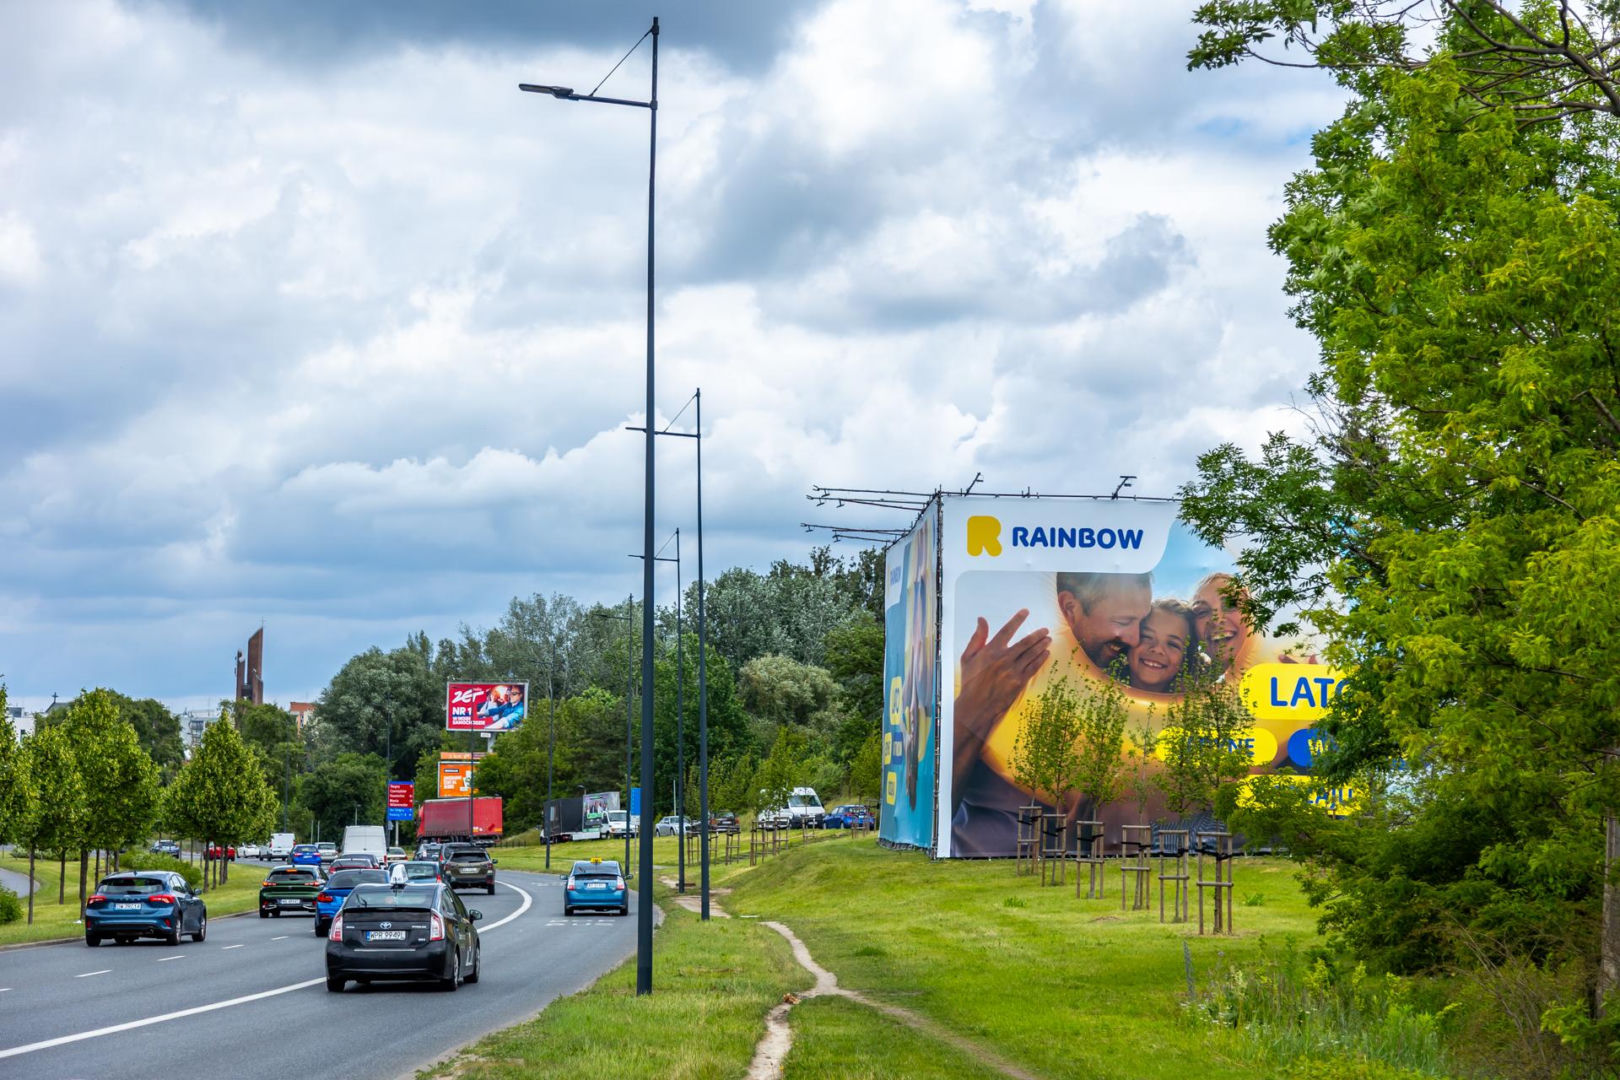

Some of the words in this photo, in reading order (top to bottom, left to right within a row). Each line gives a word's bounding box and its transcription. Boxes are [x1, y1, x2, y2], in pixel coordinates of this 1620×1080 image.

[1012, 526, 1144, 550] RAINBOW
[452, 689, 484, 704] ZET
[452, 707, 466, 716] NR
[467, 707, 472, 716] 1
